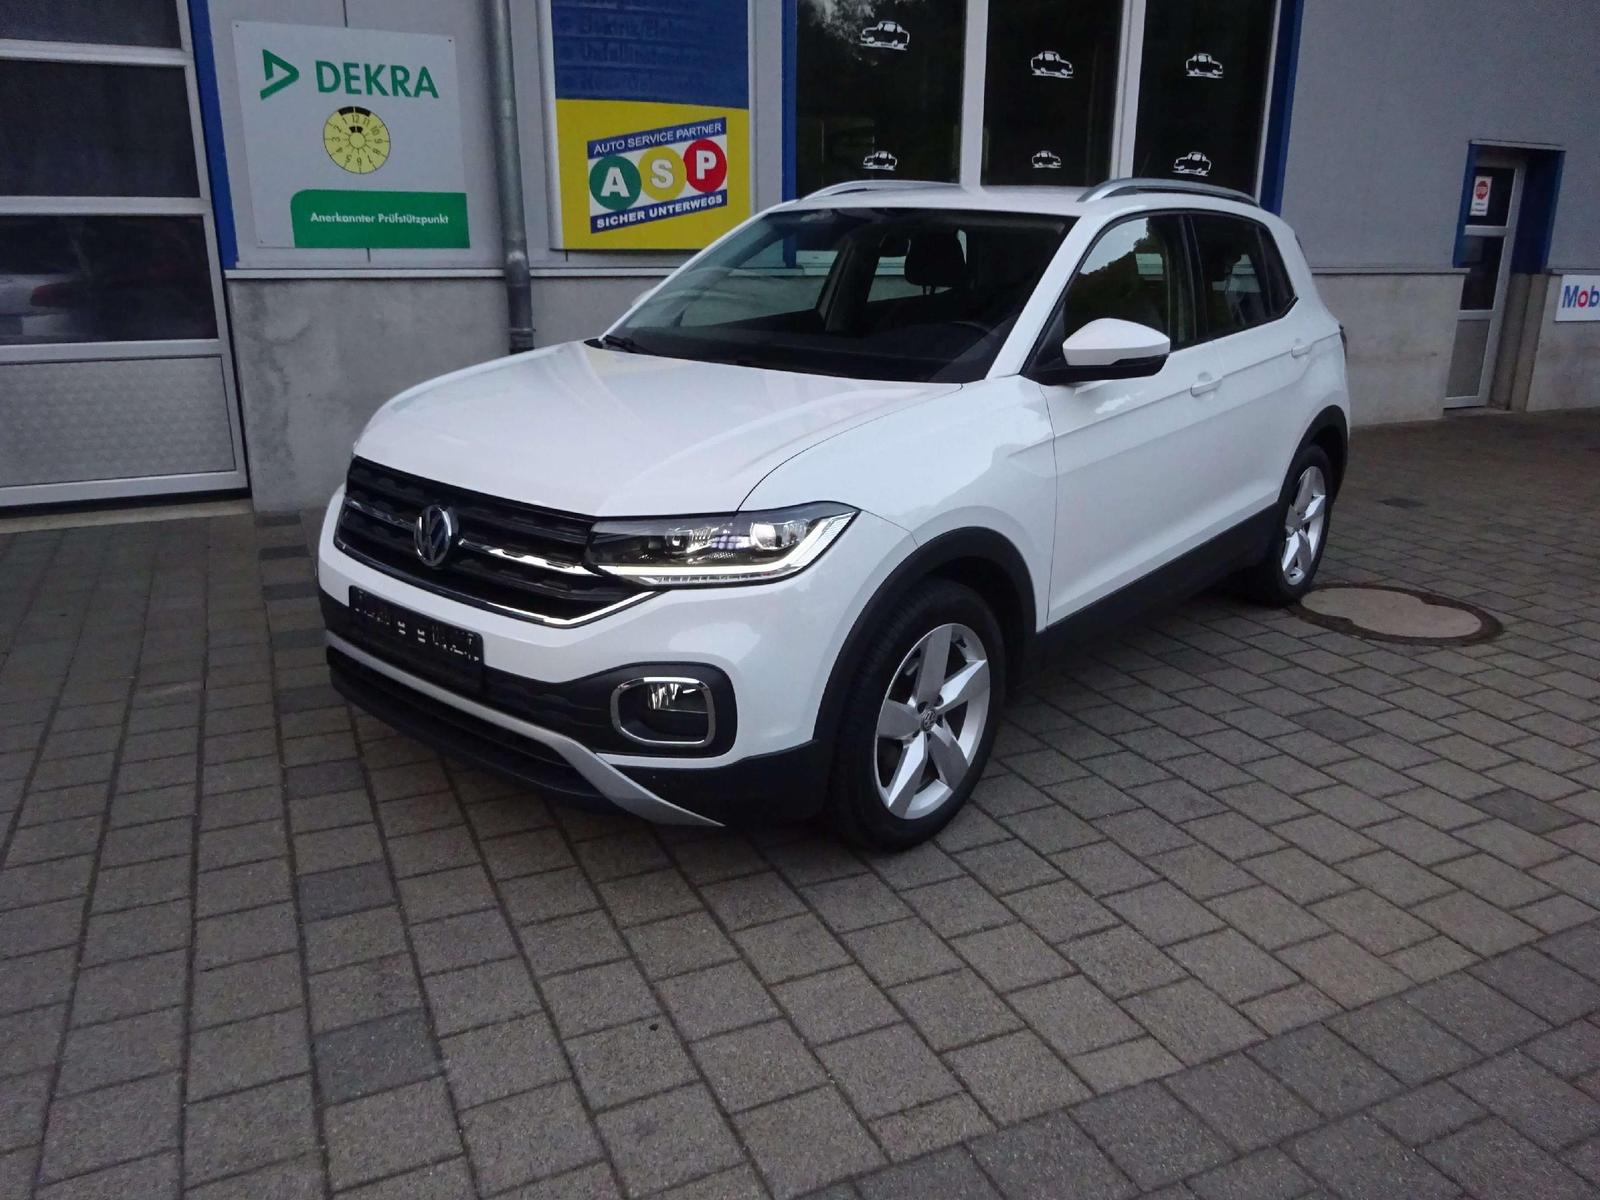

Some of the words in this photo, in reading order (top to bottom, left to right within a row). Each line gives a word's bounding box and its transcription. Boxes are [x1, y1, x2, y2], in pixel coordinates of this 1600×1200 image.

[315, 59, 440, 99] DEKRA
[593, 140, 625, 155] AUTO
[627, 131, 674, 149] SERVICE
[676, 122, 722, 139] PARTNER
[600, 150, 717, 197] ASP
[310, 212, 375, 224] Anerkannter
[378, 212, 449, 226] Prüfstützpunkt
[596, 210, 646, 229] SICHER
[649, 194, 723, 218] UNTERWEGS
